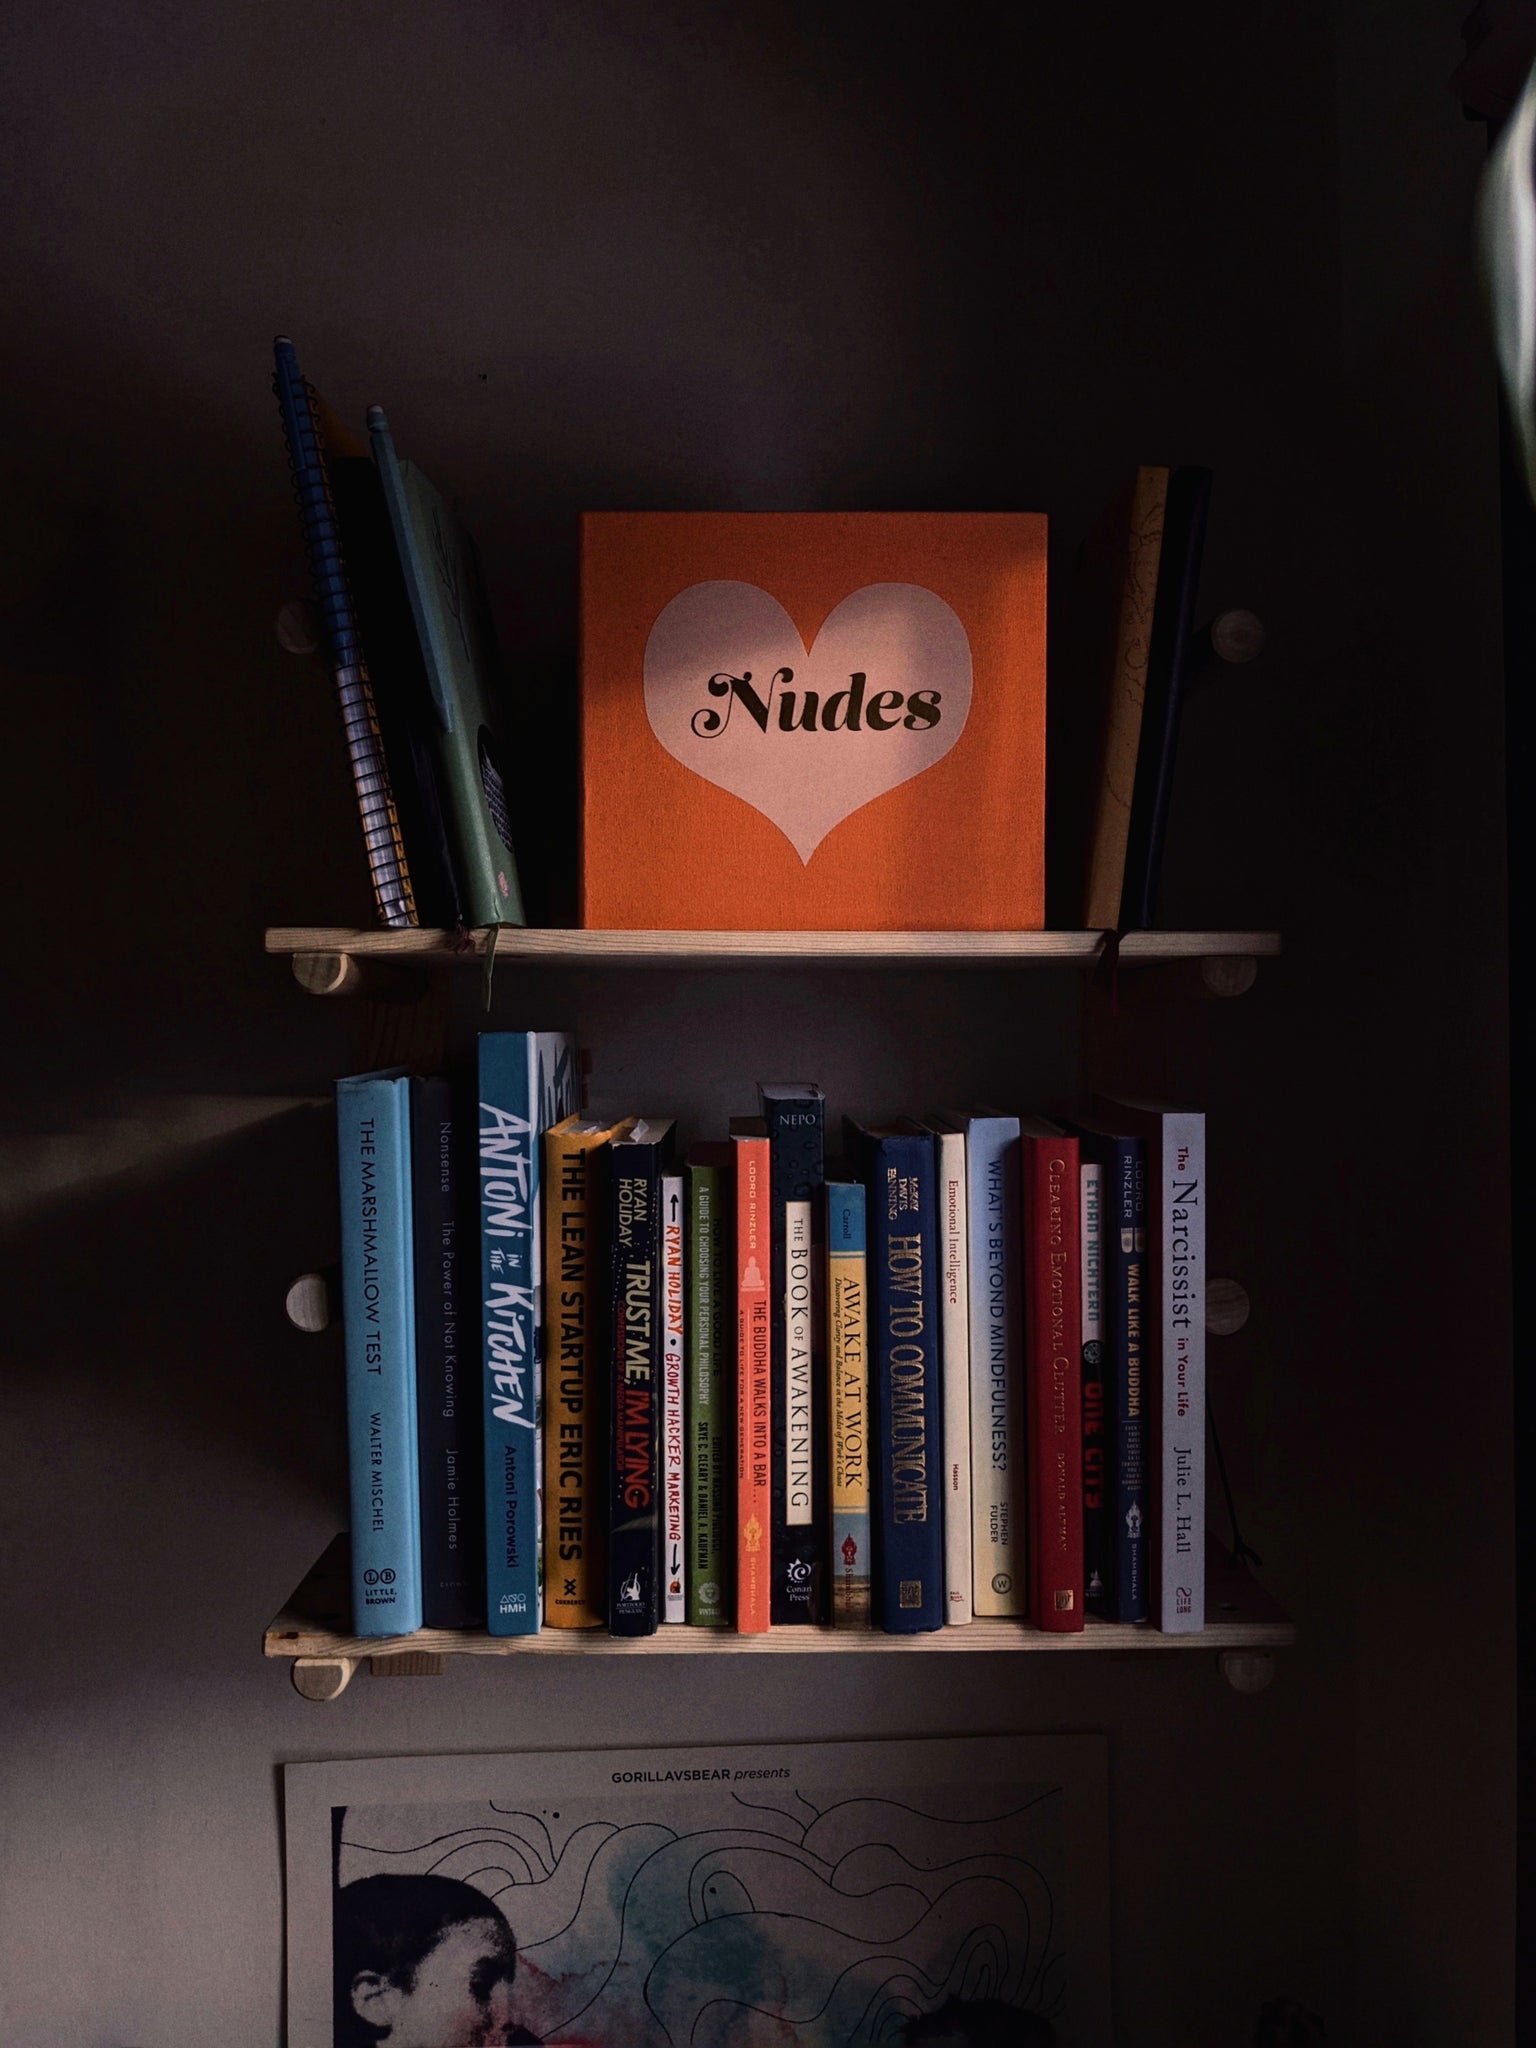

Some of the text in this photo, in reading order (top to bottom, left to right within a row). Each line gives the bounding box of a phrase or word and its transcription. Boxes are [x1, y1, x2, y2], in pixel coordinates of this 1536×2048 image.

[691, 667, 942, 739] Nudes
[779, 1113, 816, 1126] NEPO
[440, 1121, 457, 1193] Nonsense
[632, 1177, 648, 1222] RYAN
[748, 1160, 758, 1249] LODRO RINZLER
[887, 1167, 899, 1221] FANNING
[898, 1177, 909, 1212] DAVIS
[1123, 1155, 1133, 1218] RINZLER
[617, 1178, 633, 1248] HOLIDAY
[699, 1195, 710, 1220] GUIDE
[842, 1208, 852, 1240] Carroll
[360, 1118, 381, 1376] THE MARSHMALLOW TEST
[699, 1223, 710, 1233] TO
[946, 1180, 961, 1304] Emotional Intelligence
[489, 1247, 505, 1275] THE
[699, 1235, 710, 1278] CHOOSING
[1087, 1179, 1101, 1322] ETHAN NICHTERN
[699, 1280, 710, 1304] YOUR
[713, 1218, 722, 1376] HOW TO LIVE A GOOD LIFE
[834, 1277, 843, 1318] Discovering
[1127, 1263, 1141, 1304] WALK
[1172, 1146, 1199, 1417] The Narcissist in Your Life
[441, 1220, 457, 1418] The Power of Not Knowing
[699, 1306, 710, 1349] PERSONAL
[753, 1300, 767, 1322] THE
[833, 1319, 843, 1343] Clarity
[988, 1160, 1007, 1471] WHAT'S BEYOND MINDFULNESS?
[1127, 1308, 1141, 1338] LIKE
[558, 1148, 586, 1561] THE LEAN STARTUP ERIC RIES
[616, 1361, 625, 1373] OF
[753, 1326, 767, 1375] BUDDHA
[791, 1219, 809, 1507] THE BOOK OF AWAKENING
[1127, 1342, 1141, 1352] A
[623, 1259, 652, 1510] TRUST ME, I'M LYING
[665, 1225, 684, 1541] RYAN HOLIDAY GROWTH HACKER MARKETING
[699, 1352, 710, 1405] PHILOSOPHY
[835, 1360, 843, 1387] Balance
[843, 1277, 862, 1489] AWAKE AT WORK
[887, 1232, 928, 1525] HOW TO COMMUNICATE
[1127, 1357, 1141, 1417] BUDDHA
[616, 1382, 625, 1408] MEDIA
[753, 1378, 767, 1417] WALKS
[698, 1422, 709, 1441] SKYE
[753, 1421, 767, 1448] INTO
[834, 1431, 844, 1440] of
[836, 1409, 844, 1430] Midst
[698, 1443, 709, 1451] C.
[753, 1452, 767, 1460] A
[836, 1441, 844, 1465] Work's
[1084, 1382, 1105, 1510] ONE CITY
[370, 1412, 385, 1533] WALTER MISCHEL
[698, 1454, 709, 1482] CLEARY
[952, 1463, 960, 1491] Hasson
[446, 1449, 461, 1550] Jamie Holmes
[504, 1445, 520, 1568] Antoni Porowski
[698, 1493, 709, 1519] DANIEL
[1056, 1452, 1068, 1552] DONALD ALTMAN
[1173, 1447, 1192, 1554] Julie L. Hall
[698, 1522, 709, 1531] A.
[990, 1504, 999, 1543] FULDER
[1000, 1501, 1009, 1546] STEPHEN
[698, 1532, 709, 1569] KAUFMAN
[366, 1597, 396, 1605] BROWN
[499, 1603, 527, 1614] HMH
[786, 1585, 813, 1593] Conari
[789, 1593, 811, 1602] Press
[1176, 1606, 1192, 1614] LONG
[611, 1767, 791, 1783] GORILLAVSBEAR presents
